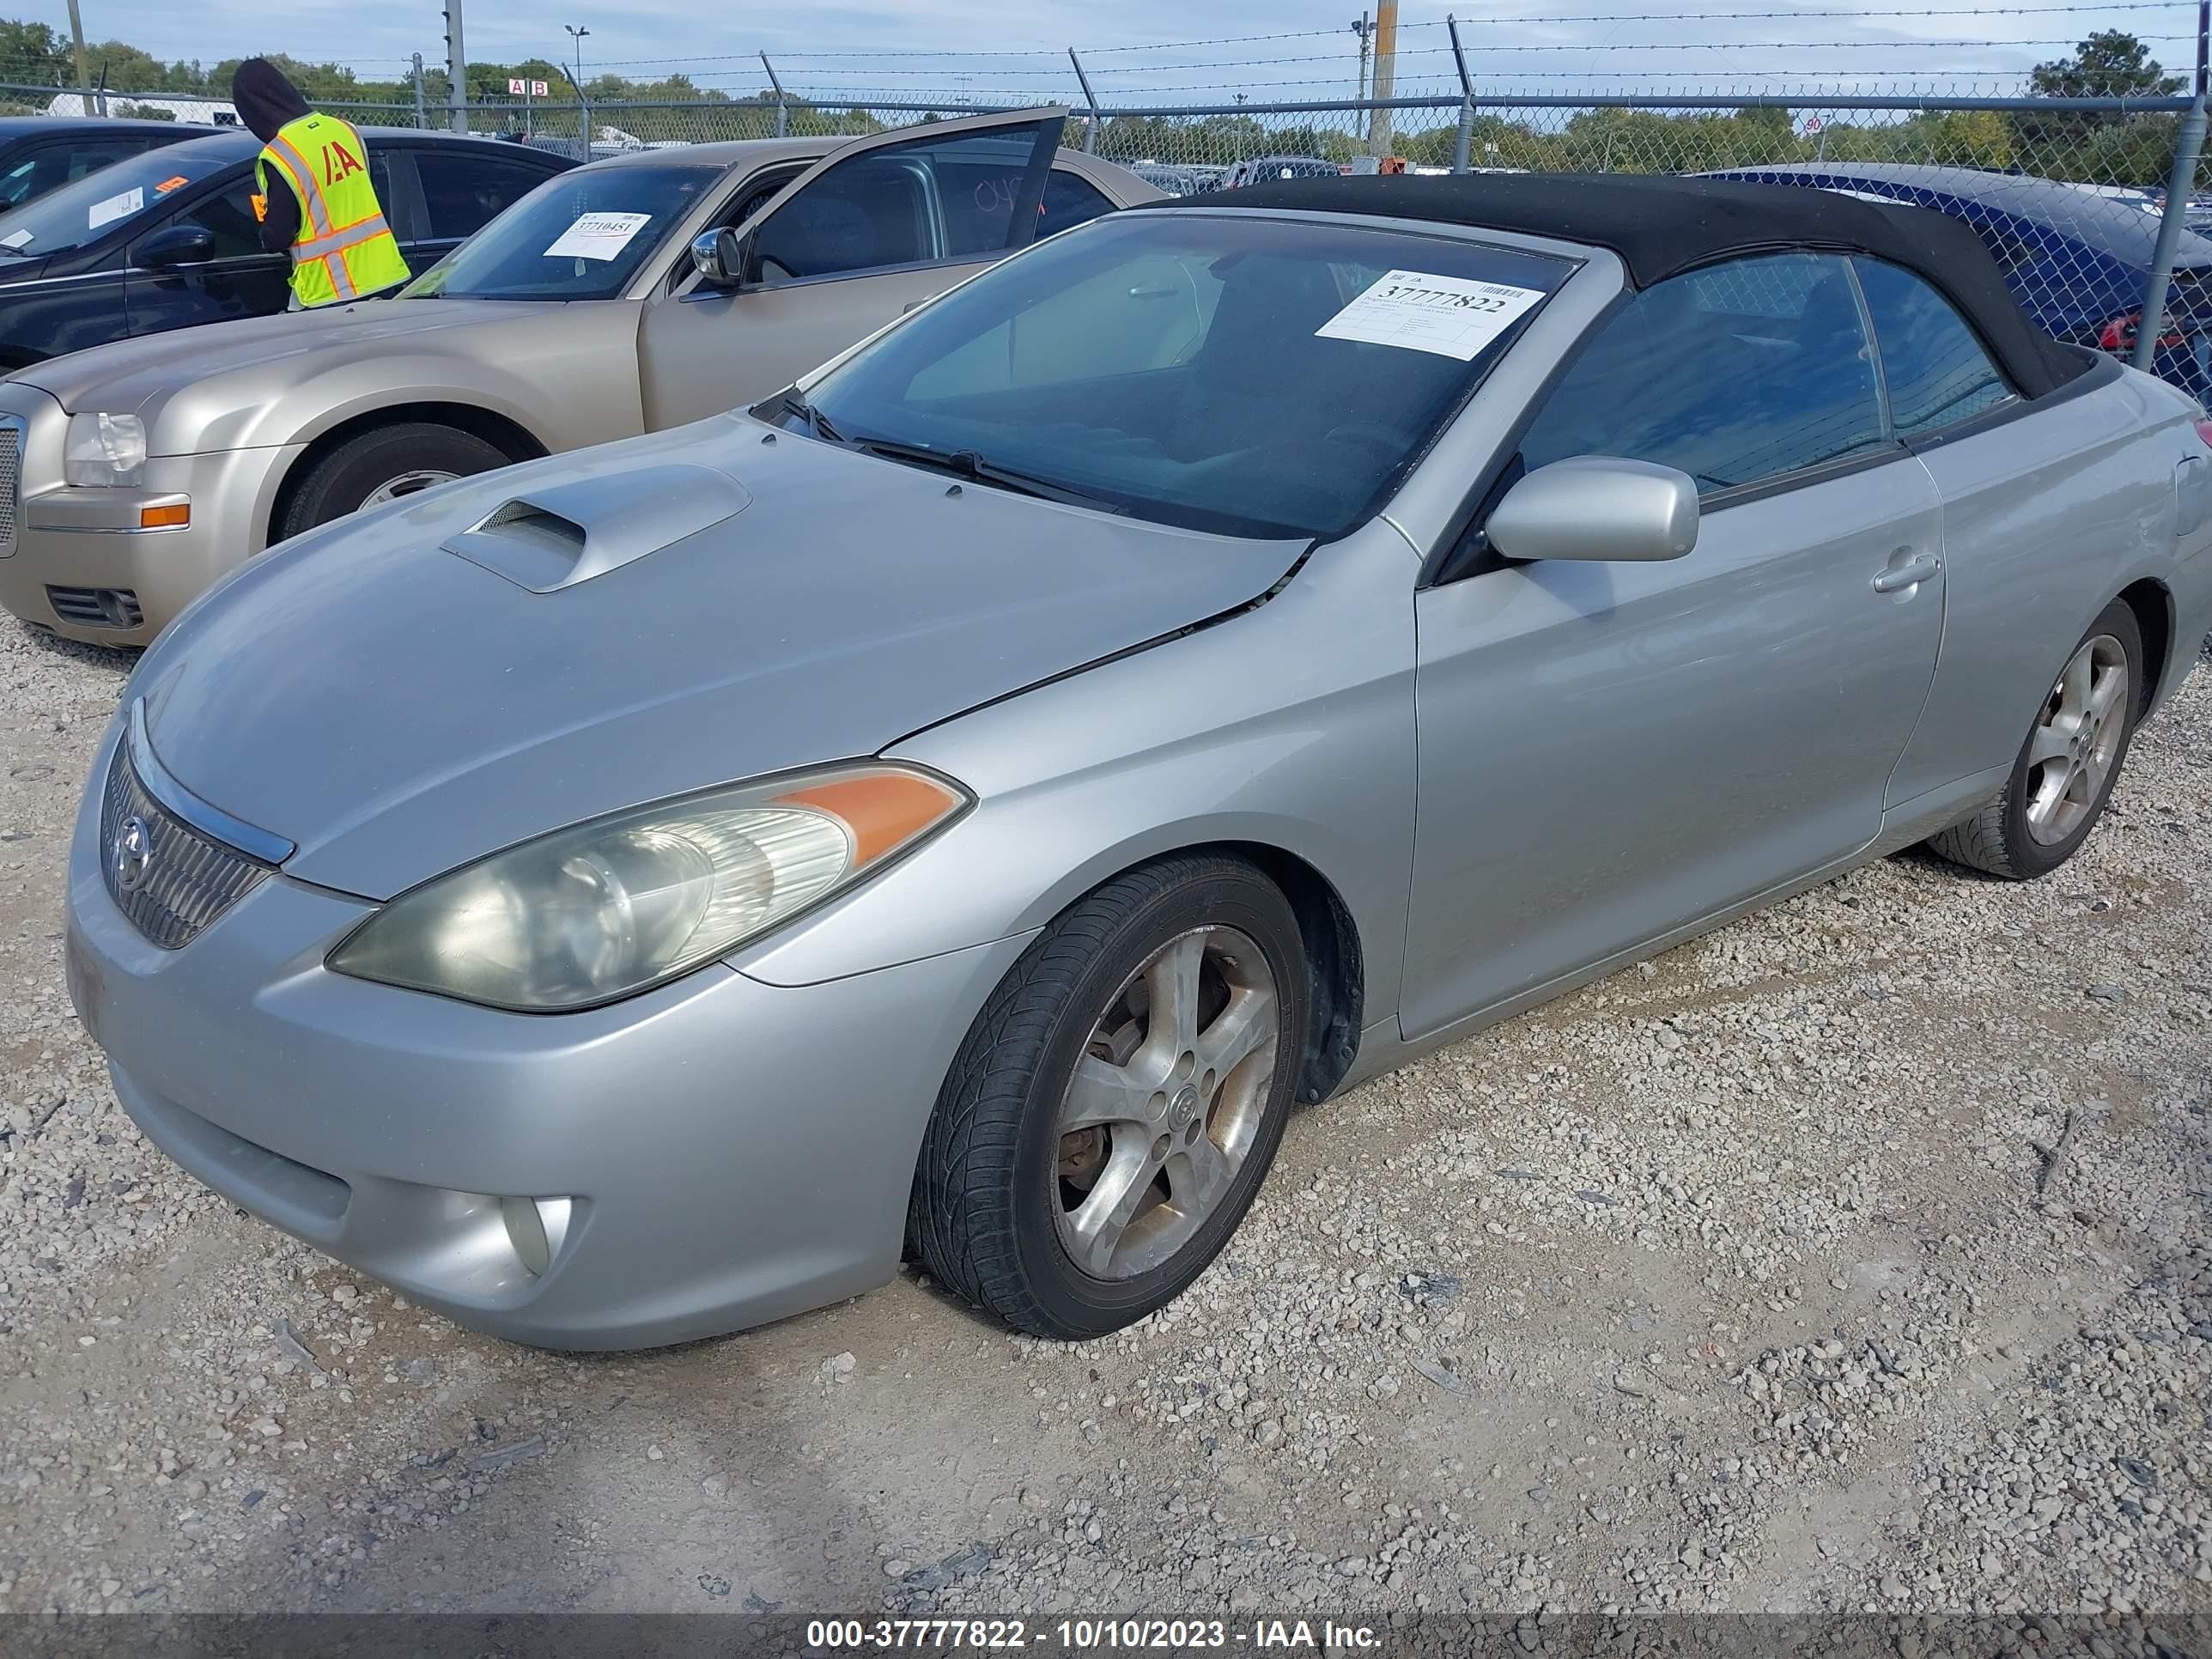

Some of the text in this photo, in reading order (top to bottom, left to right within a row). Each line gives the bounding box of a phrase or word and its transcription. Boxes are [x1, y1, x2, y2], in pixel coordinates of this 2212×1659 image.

[512, 81, 523, 93] A
[535, 82, 545, 94] B
[1806, 118, 1821, 130] 90
[574, 222, 632, 232] 37710451
[1377, 285, 1506, 313] 37777822
